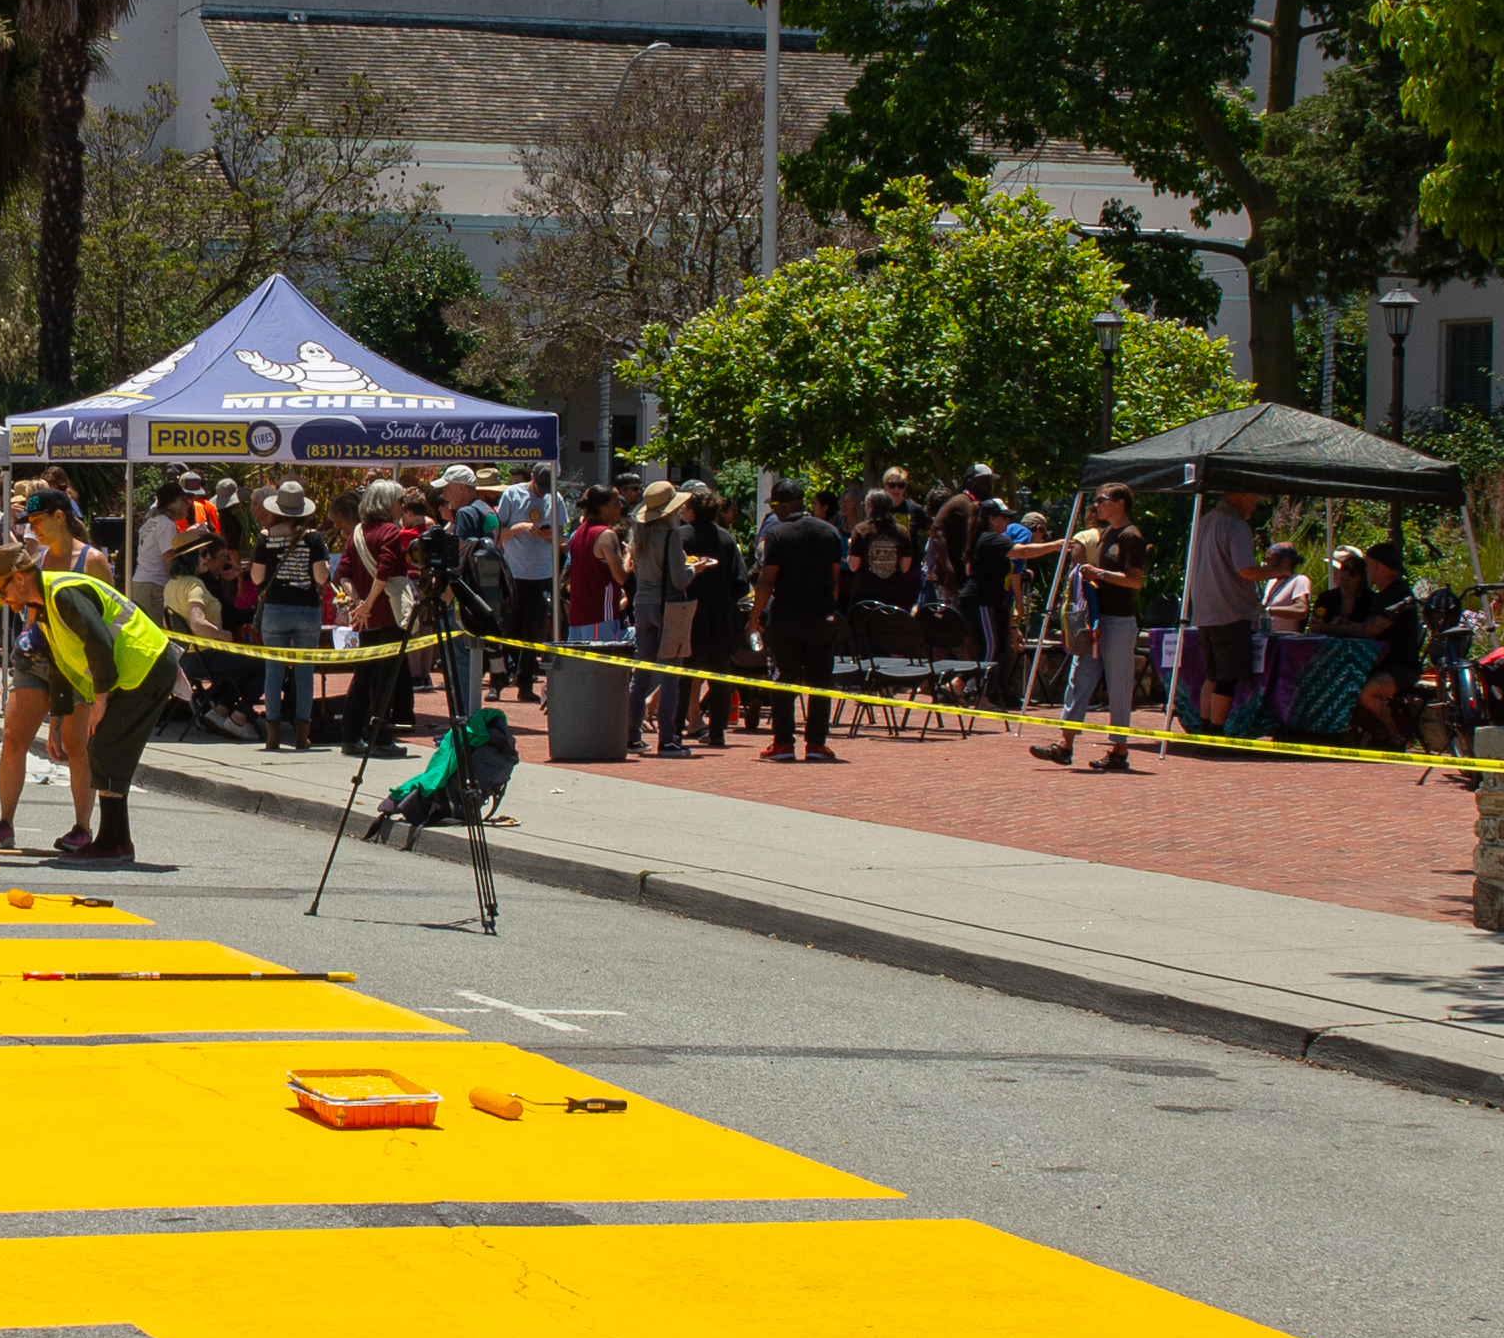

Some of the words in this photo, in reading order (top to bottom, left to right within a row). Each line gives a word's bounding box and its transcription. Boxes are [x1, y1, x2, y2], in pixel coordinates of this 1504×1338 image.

[222, 396, 455, 409] MICHELIN
[158, 429, 241, 447] PRIORS
[254, 433, 274, 445] TIRES
[381, 421, 428, 440] Santa
[431, 422, 467, 445] Cruz,
[470, 422, 540, 443] California
[306, 444, 342, 458] (831)
[345, 446, 409, 457] 212-4555
[421, 446, 541, 458] PRIORSTIRES.com
